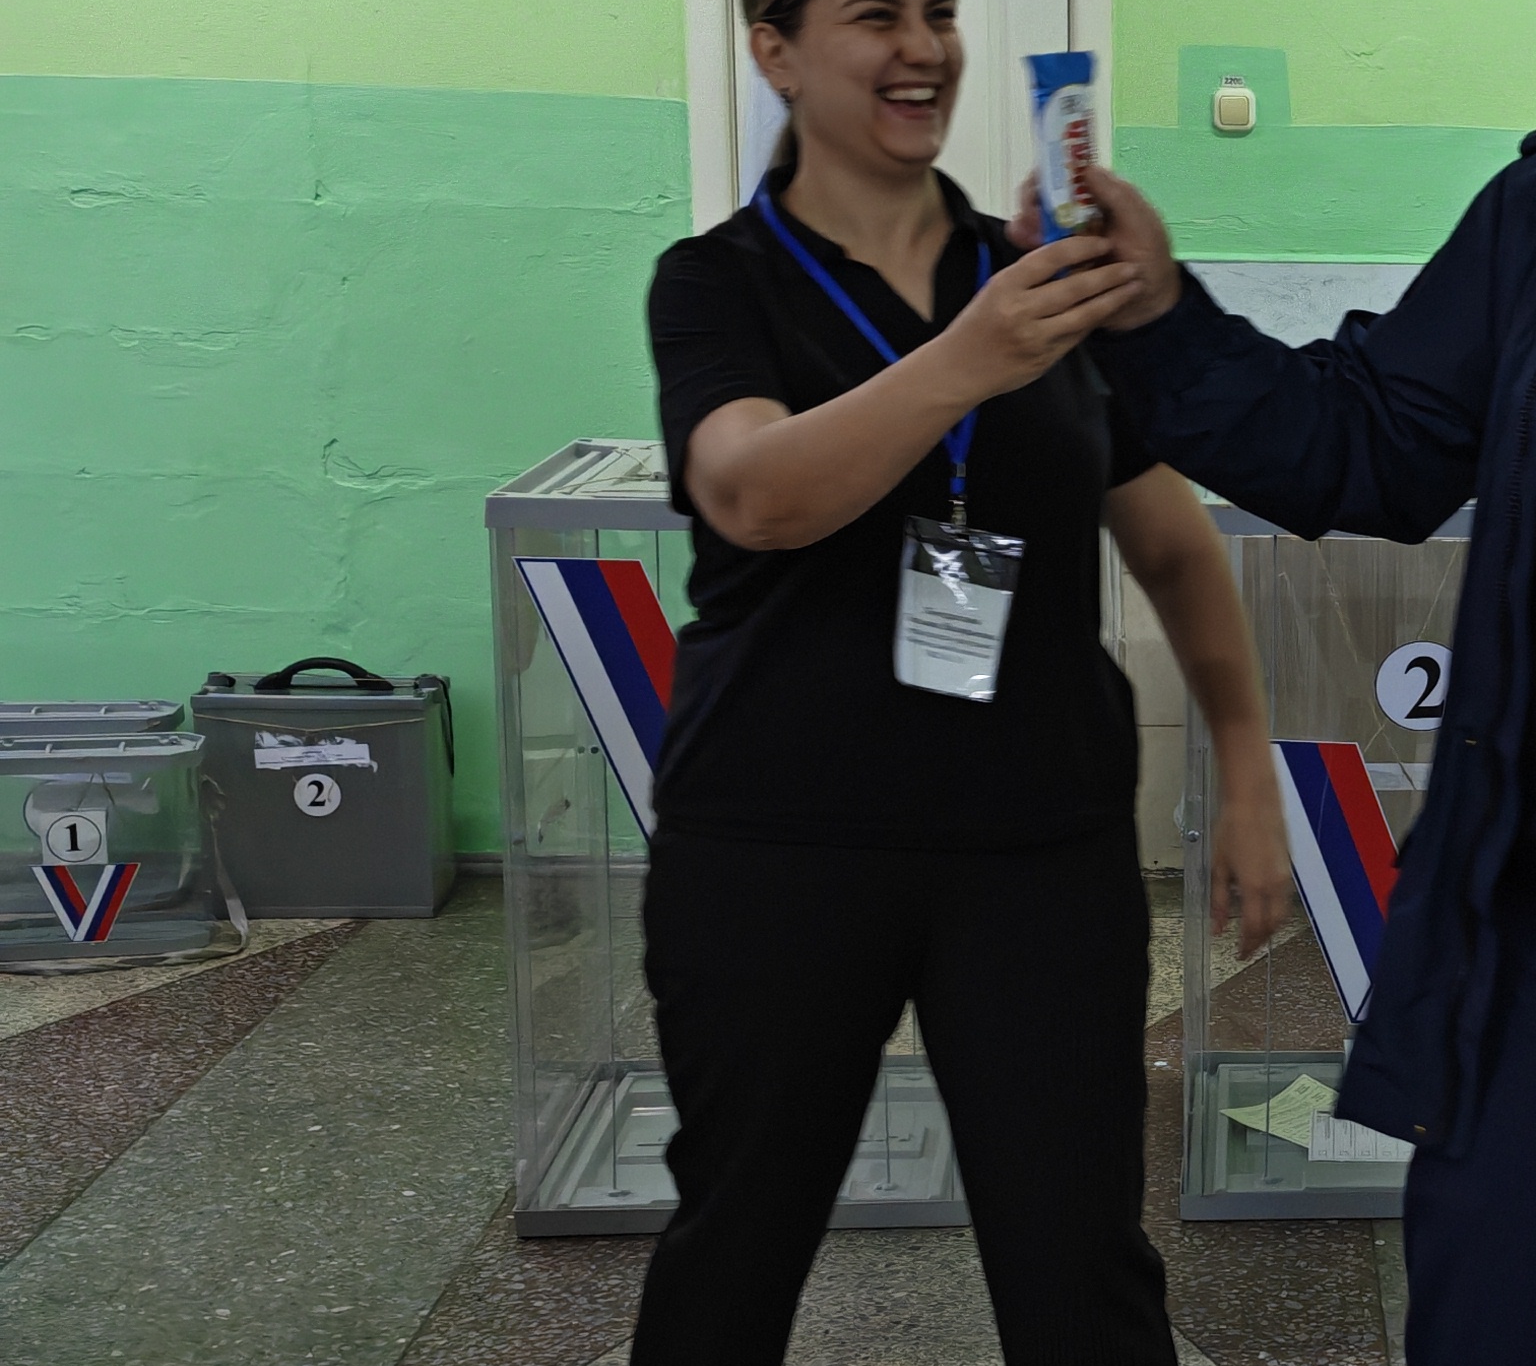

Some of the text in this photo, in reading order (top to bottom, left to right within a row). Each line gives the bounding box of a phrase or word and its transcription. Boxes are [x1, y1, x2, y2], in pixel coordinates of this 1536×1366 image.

[1404, 656, 1445, 719] 2
[307, 780, 326, 807] 2
[64, 823, 83, 852] 1
